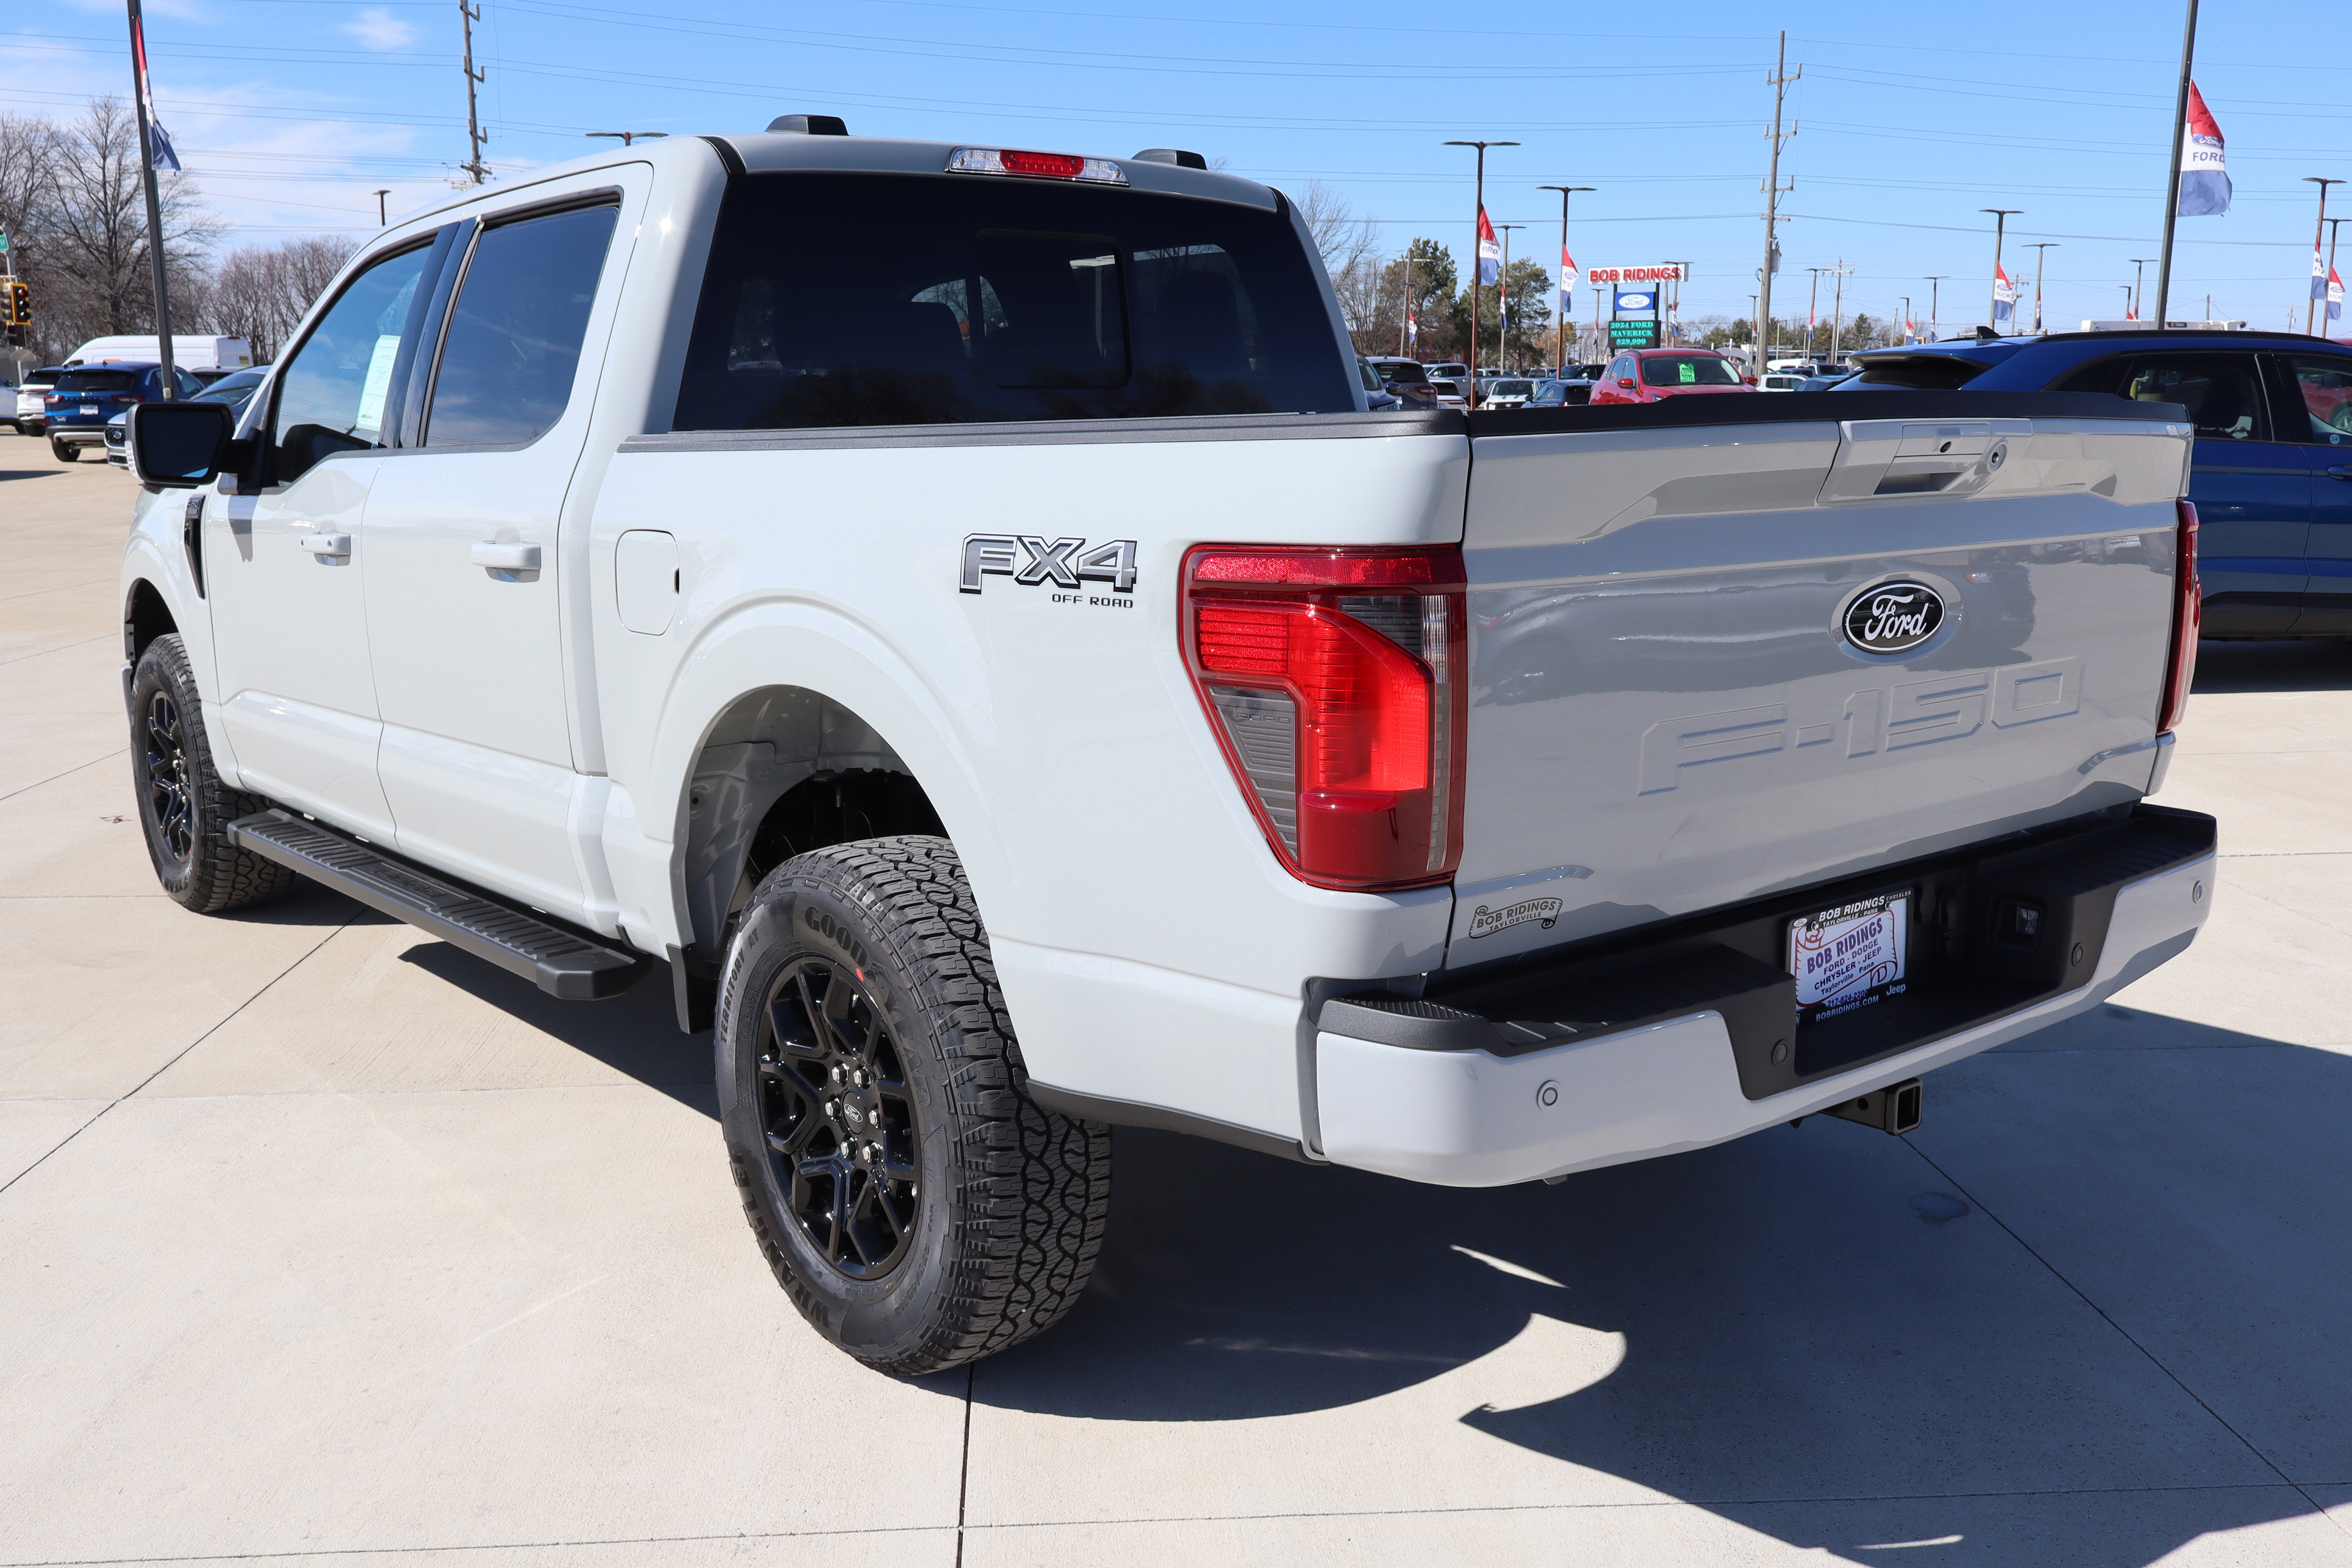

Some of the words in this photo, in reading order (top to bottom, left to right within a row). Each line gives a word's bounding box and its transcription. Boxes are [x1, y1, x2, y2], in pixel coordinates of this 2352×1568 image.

[2193, 151, 2225, 163] FORD
[1590, 269, 1618, 282] BOB
[1624, 267, 1681, 281] RIDINGS
[1626, 296, 1643, 305] Ford
[959, 532, 1138, 595] FX4
[1052, 594, 1082, 604] OFF
[1090, 597, 1134, 608] ROAD
[1864, 594, 1928, 641] Ford
[1236, 712, 1291, 725] FORD
[1637, 657, 2083, 797] F-150
[1818, 906, 1840, 922] BOB
[1844, 895, 1885, 915] RIDINGS
[1886, 890, 1911, 901] CHRYSLER
[1477, 912, 1502, 929] BOB
[1507, 901, 1556, 919] RIDINGS
[1490, 911, 1542, 931] TAYLORVILLE
[1822, 913, 1859, 927] TAYLORVILLE
[1864, 908, 1878, 916] PANA
[1807, 947, 1833, 974] BOB
[1836, 917, 1883, 958] RIDINGS
[1824, 959, 1845, 976] FORD
[1852, 938, 1879, 958] DODGE
[1814, 962, 1856, 991] CHRYSLER
[1863, 946, 1882, 964] JEEP
[1820, 973, 1854, 996] Taylorville
[1859, 961, 1874, 974] Pana
[720, 949, 746, 1044] TERRITORY
[748, 927, 759, 949] AT
[1886, 983, 1906, 996] Jeep
[1816, 995, 1879, 1022] BOBRIDINGS.COM
[847, 1106, 859, 1120] Ford
[728, 1138, 831, 1330] WRANGLER
